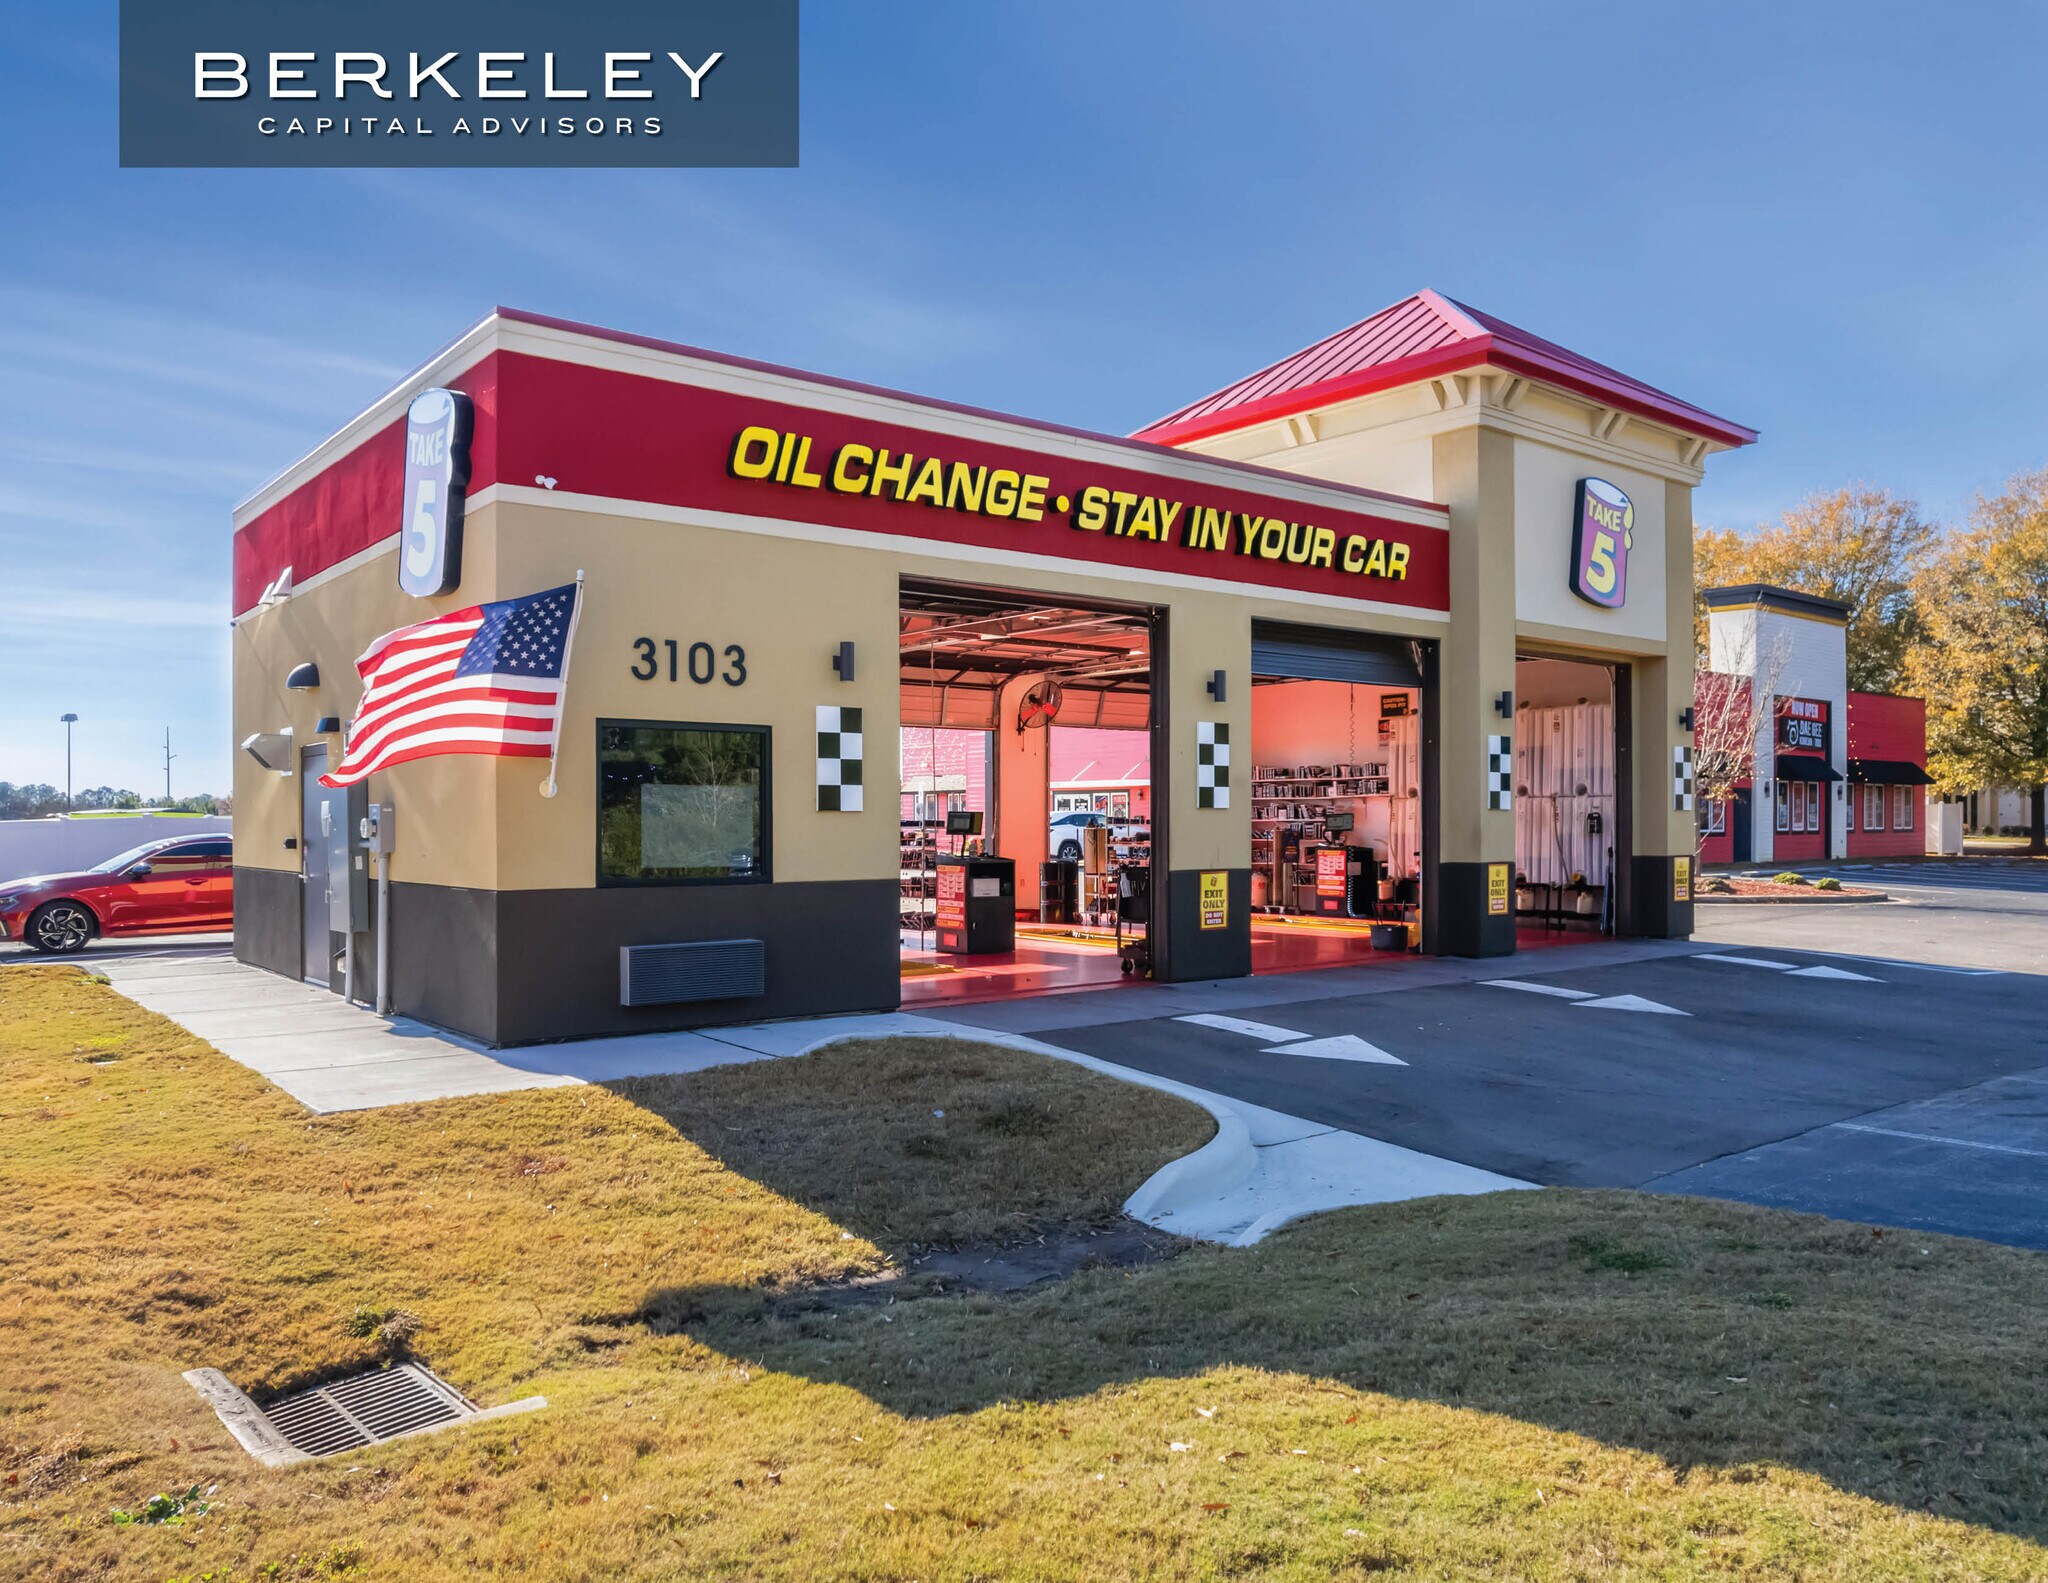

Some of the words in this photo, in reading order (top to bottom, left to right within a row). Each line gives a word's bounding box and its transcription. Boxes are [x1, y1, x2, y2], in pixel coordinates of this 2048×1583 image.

[409, 428, 445, 467] TAKE
[732, 426, 821, 489] OIL
[831, 443, 1050, 522] CHANGE
[1076, 486, 1182, 542] STAY
[1186, 505, 1232, 551] IN
[1240, 513, 1336, 568] YOUR
[1341, 534, 1411, 580] CAR
[1586, 495, 1622, 532] TAKE
[406, 479, 437, 577] 5
[1585, 531, 1616, 594] 5
[631, 637, 747, 687] 3103
[1203, 900, 1225, 909] ONLY
[1204, 890, 1224, 899] EXIT
